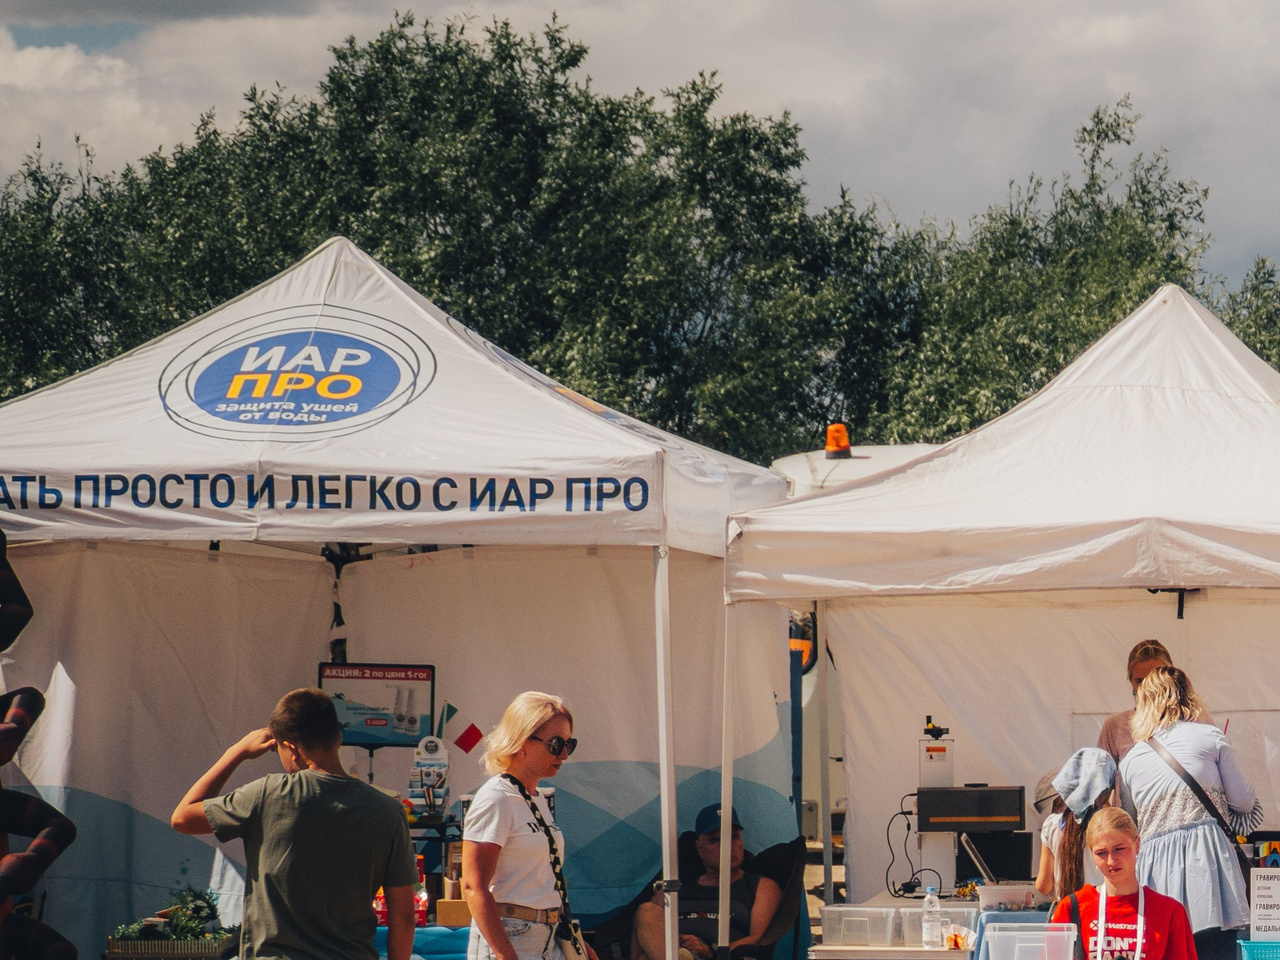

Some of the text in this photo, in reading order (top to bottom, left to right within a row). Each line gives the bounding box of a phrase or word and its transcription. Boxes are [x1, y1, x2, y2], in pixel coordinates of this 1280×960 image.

[240, 345, 372, 372] ИАР
[225, 373, 363, 400] ПРО
[73, 473, 236, 509] ПРОСТО
[246, 474, 275, 510] И
[285, 473, 422, 511] ЛЕГКО
[432, 476, 458, 511] С
[469, 476, 554, 512] ИАР
[565, 476, 649, 512] ПРО
[324, 668, 362, 677] АКЦИЯ:
[364, 669, 371, 677] 2
